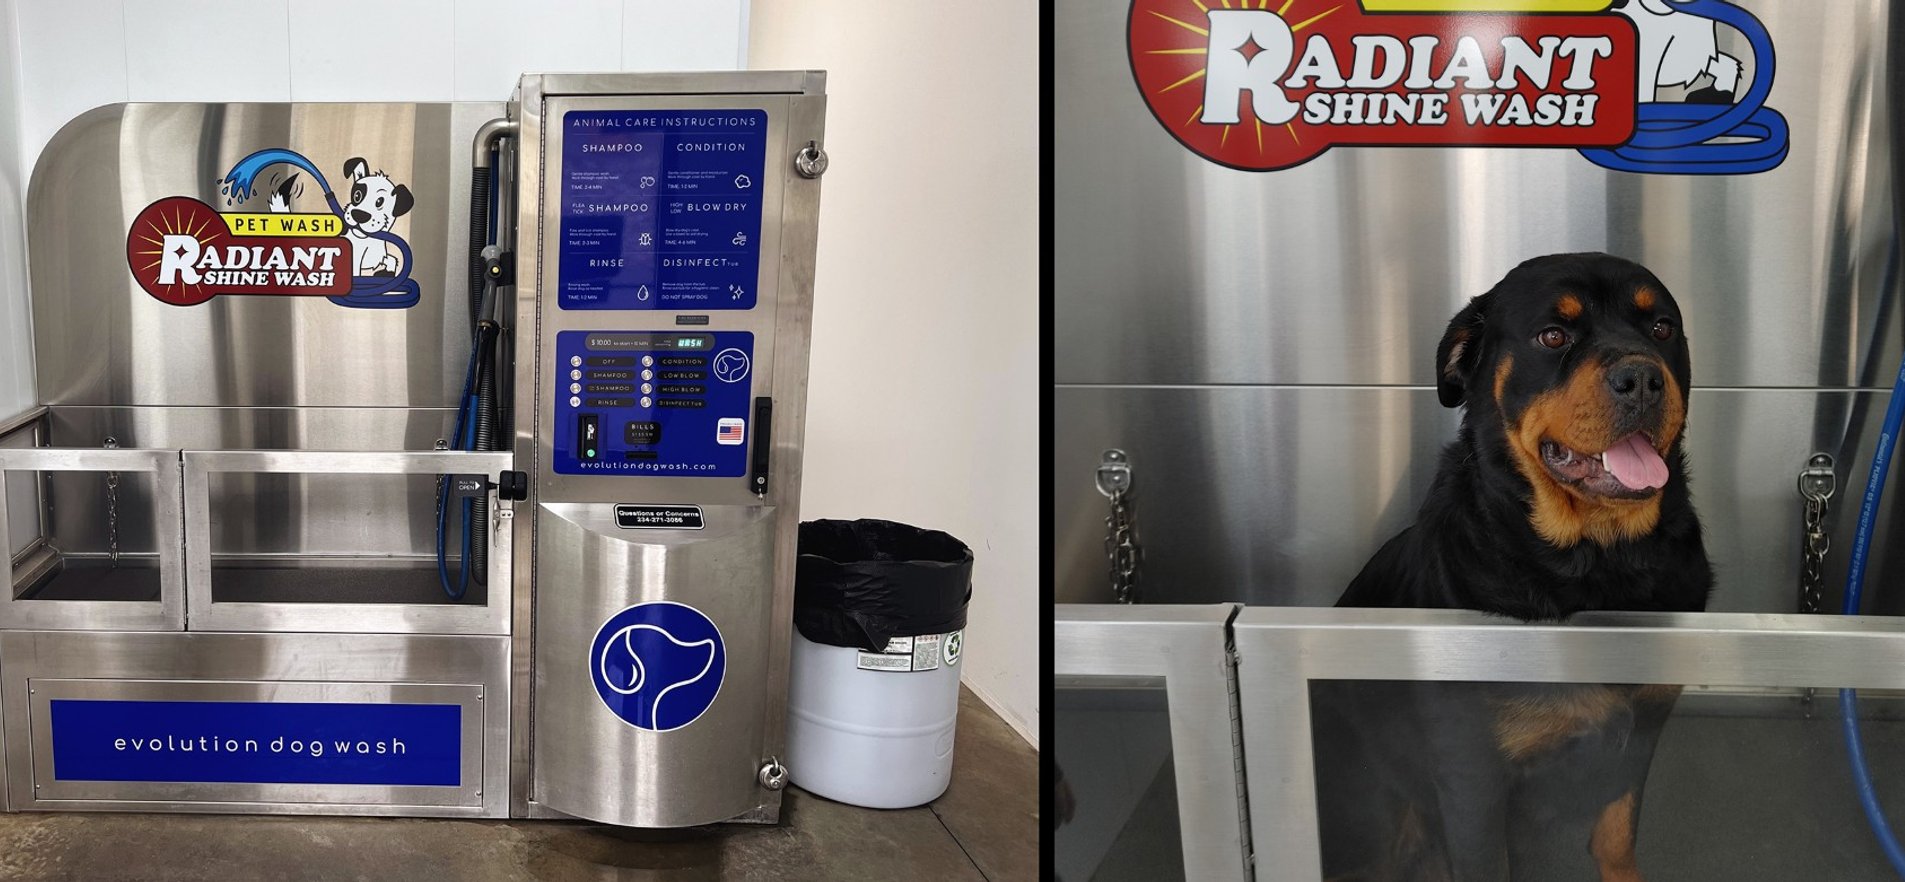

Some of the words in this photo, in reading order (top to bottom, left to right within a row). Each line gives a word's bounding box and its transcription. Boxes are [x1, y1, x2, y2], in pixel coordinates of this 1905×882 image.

[1201, 8, 1612, 126] RADIANT
[1303, 92, 1447, 126] SHINE
[1459, 94, 1600, 126] WASH
[573, 118, 621, 127] ANIMAL
[625, 118, 657, 127] CARE
[660, 117, 756, 127] INSTRUCTIONS
[582, 143, 643, 153] SHAMPOO
[676, 143, 745, 152] CONDITION
[588, 203, 649, 213] SHAMPOO
[687, 203, 721, 212] BLOW
[724, 203, 747, 212] DRY
[235, 218, 269, 232] PET
[281, 219, 335, 233] WASH
[158, 234, 342, 285] RADIANT
[589, 258, 624, 267] RINSE
[663, 258, 728, 267] DISINFECT
[202, 271, 269, 287] SHINE
[274, 272, 336, 288] WASH
[580, 461, 717, 471] evolutiondogwash.com
[618, 510, 655, 518] Questions
[665, 510, 700, 518] Concerns
[114, 735, 258, 752] evolution
[270, 736, 324, 758] dog
[334, 738, 407, 755] wash
